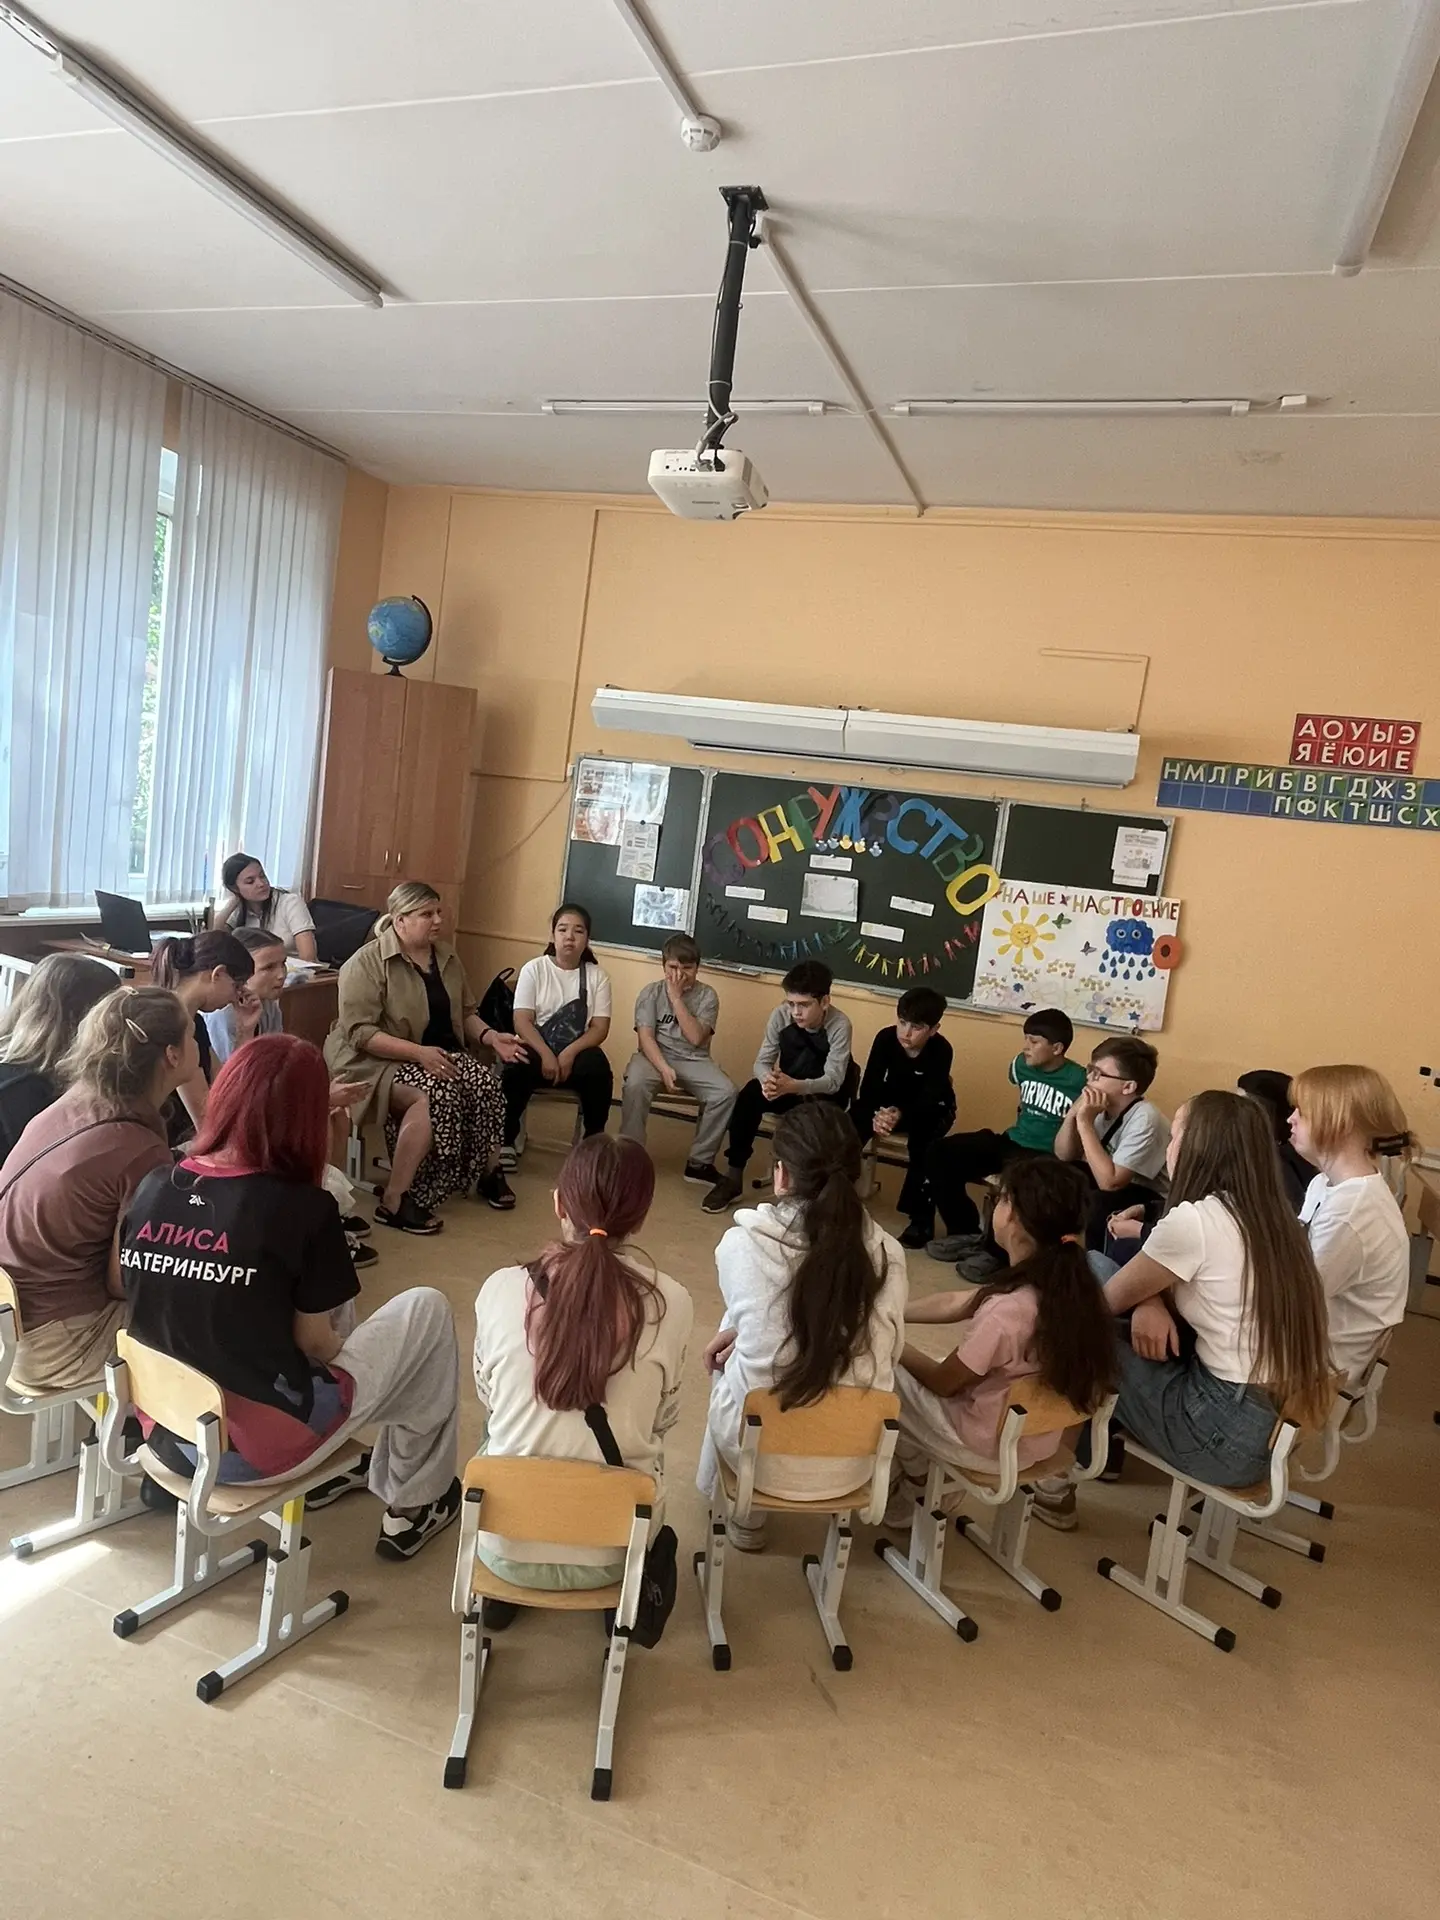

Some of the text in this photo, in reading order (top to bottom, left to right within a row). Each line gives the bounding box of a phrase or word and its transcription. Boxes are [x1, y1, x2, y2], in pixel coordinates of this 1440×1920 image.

[1002, 886, 1179, 920] НАШЕ НАСТРОЕНИЕ
[1020, 1080, 1074, 1118] ORWARD
[136, 1220, 229, 1253] АЛИСА
